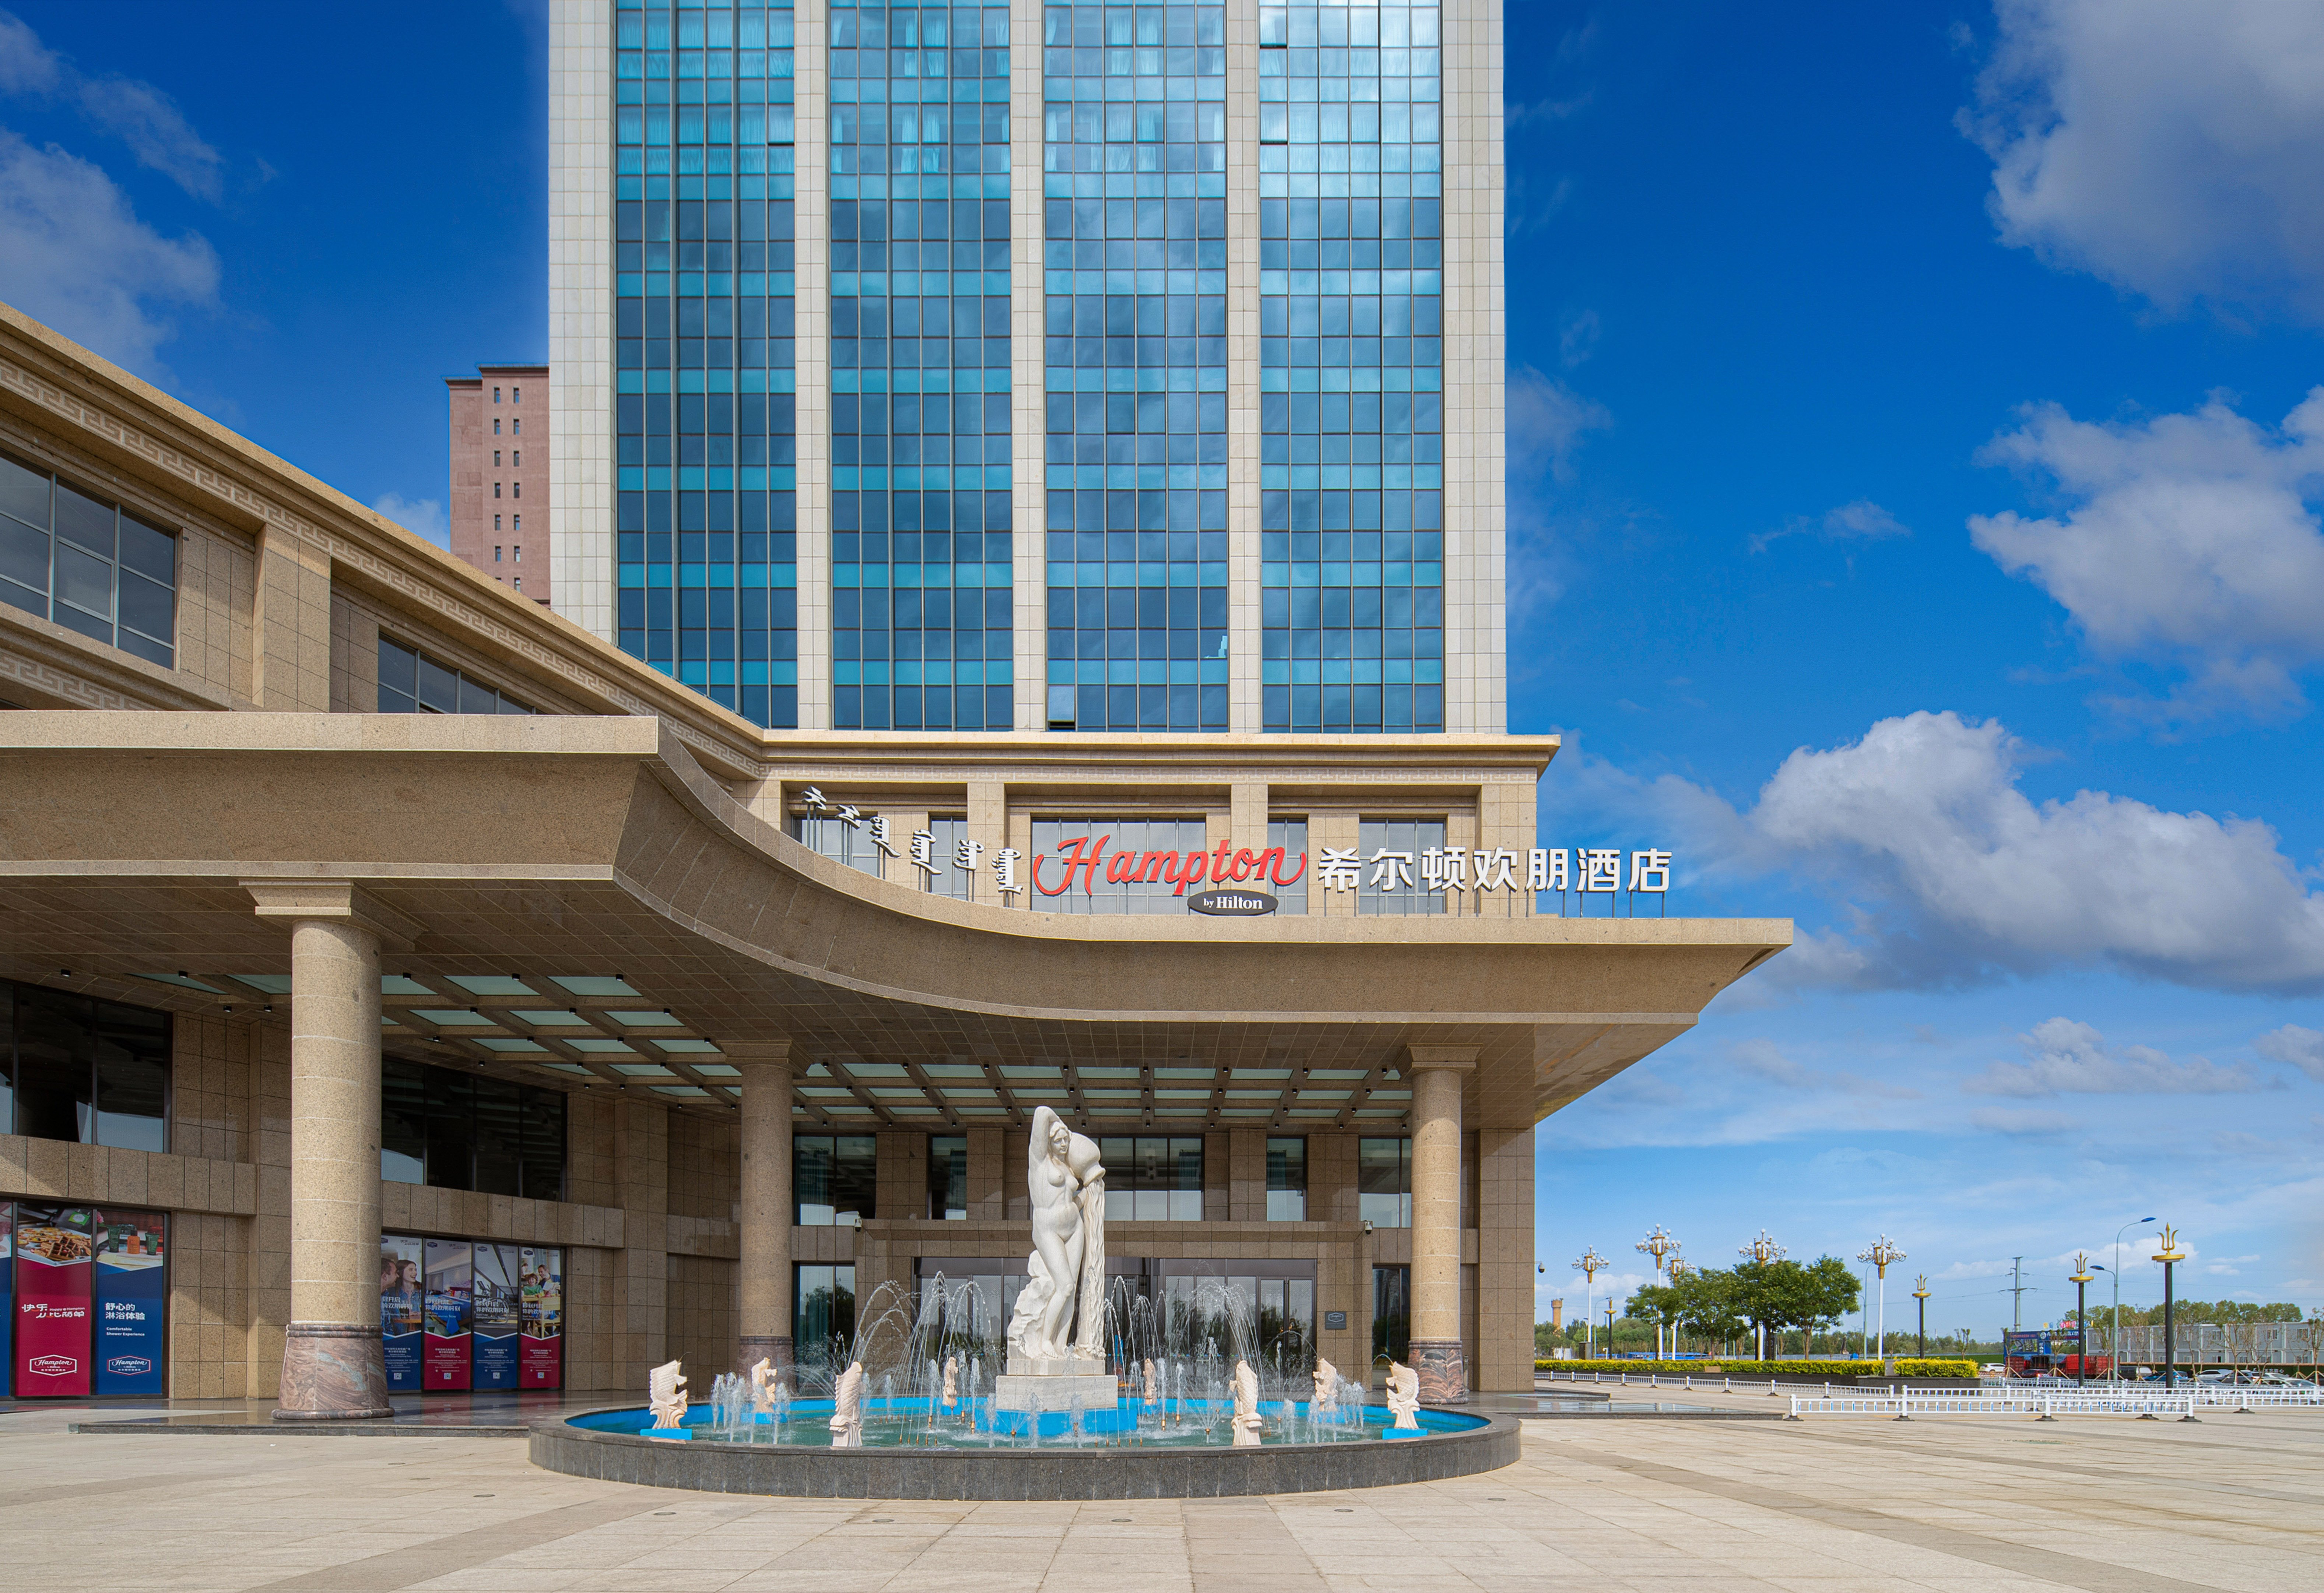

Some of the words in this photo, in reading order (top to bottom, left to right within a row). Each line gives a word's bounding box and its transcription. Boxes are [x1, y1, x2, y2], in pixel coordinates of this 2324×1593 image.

[1033, 834, 1306, 896] Hampton
[1318, 846, 1672, 892] 希尔顿欢朋酒店
[1203, 898, 1214, 908] by
[1216, 896, 1263, 910] Hilton
[21, 1304, 48, 1312] 快乐
[105, 1302, 135, 1311] 舒心的
[105, 1311, 145, 1320] 淋浴体验
